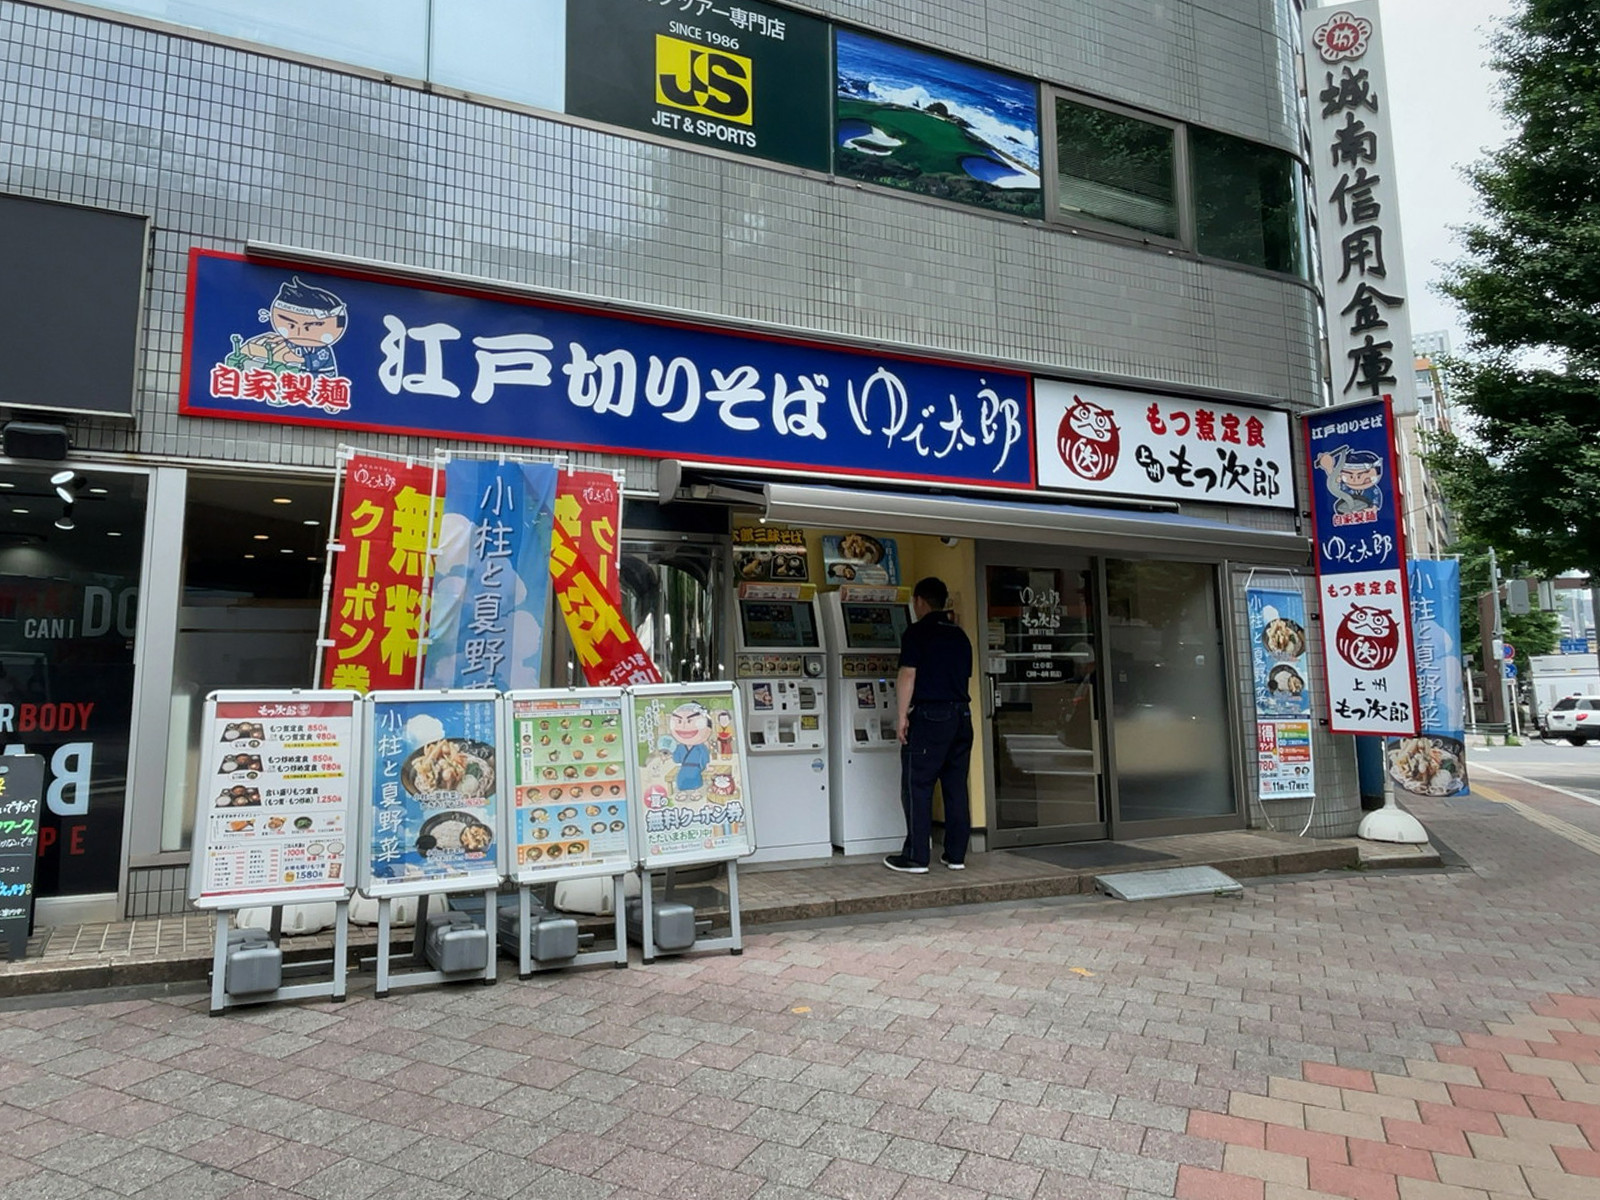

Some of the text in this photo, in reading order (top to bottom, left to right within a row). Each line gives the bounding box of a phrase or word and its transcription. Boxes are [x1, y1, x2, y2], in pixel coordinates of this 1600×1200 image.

[668, 20, 740, 50] SINCE 1986
[658, 50, 750, 117] JS
[651, 111, 757, 149] JET & SPORTS
[1318, 65, 1405, 397] 城南信用金庫
[208, 364, 353, 411] 自家製麺
[377, 313, 1023, 475] 江戸切りそば ゆで太郎
[1146, 402, 1267, 449] もつ煮定食
[1311, 414, 1384, 441] 江戸切りそば
[1166, 444, 1281, 500] もつ次郎
[1332, 509, 1378, 527] 自家製麺
[1322, 530, 1394, 565] ゆで太郎
[459, 475, 514, 690] 小柱と夏野
[1326, 579, 1397, 598] もつ煮定食
[24, 618, 64, 640] CAN
[1352, 676, 1388, 693] 上州
[18, 702, 94, 734] BODY
[1334, 698, 1410, 723] もつ次郎
[376, 708, 404, 864] 小柱と夏野菜
[645, 800, 745, 833] 無料クーポン券
